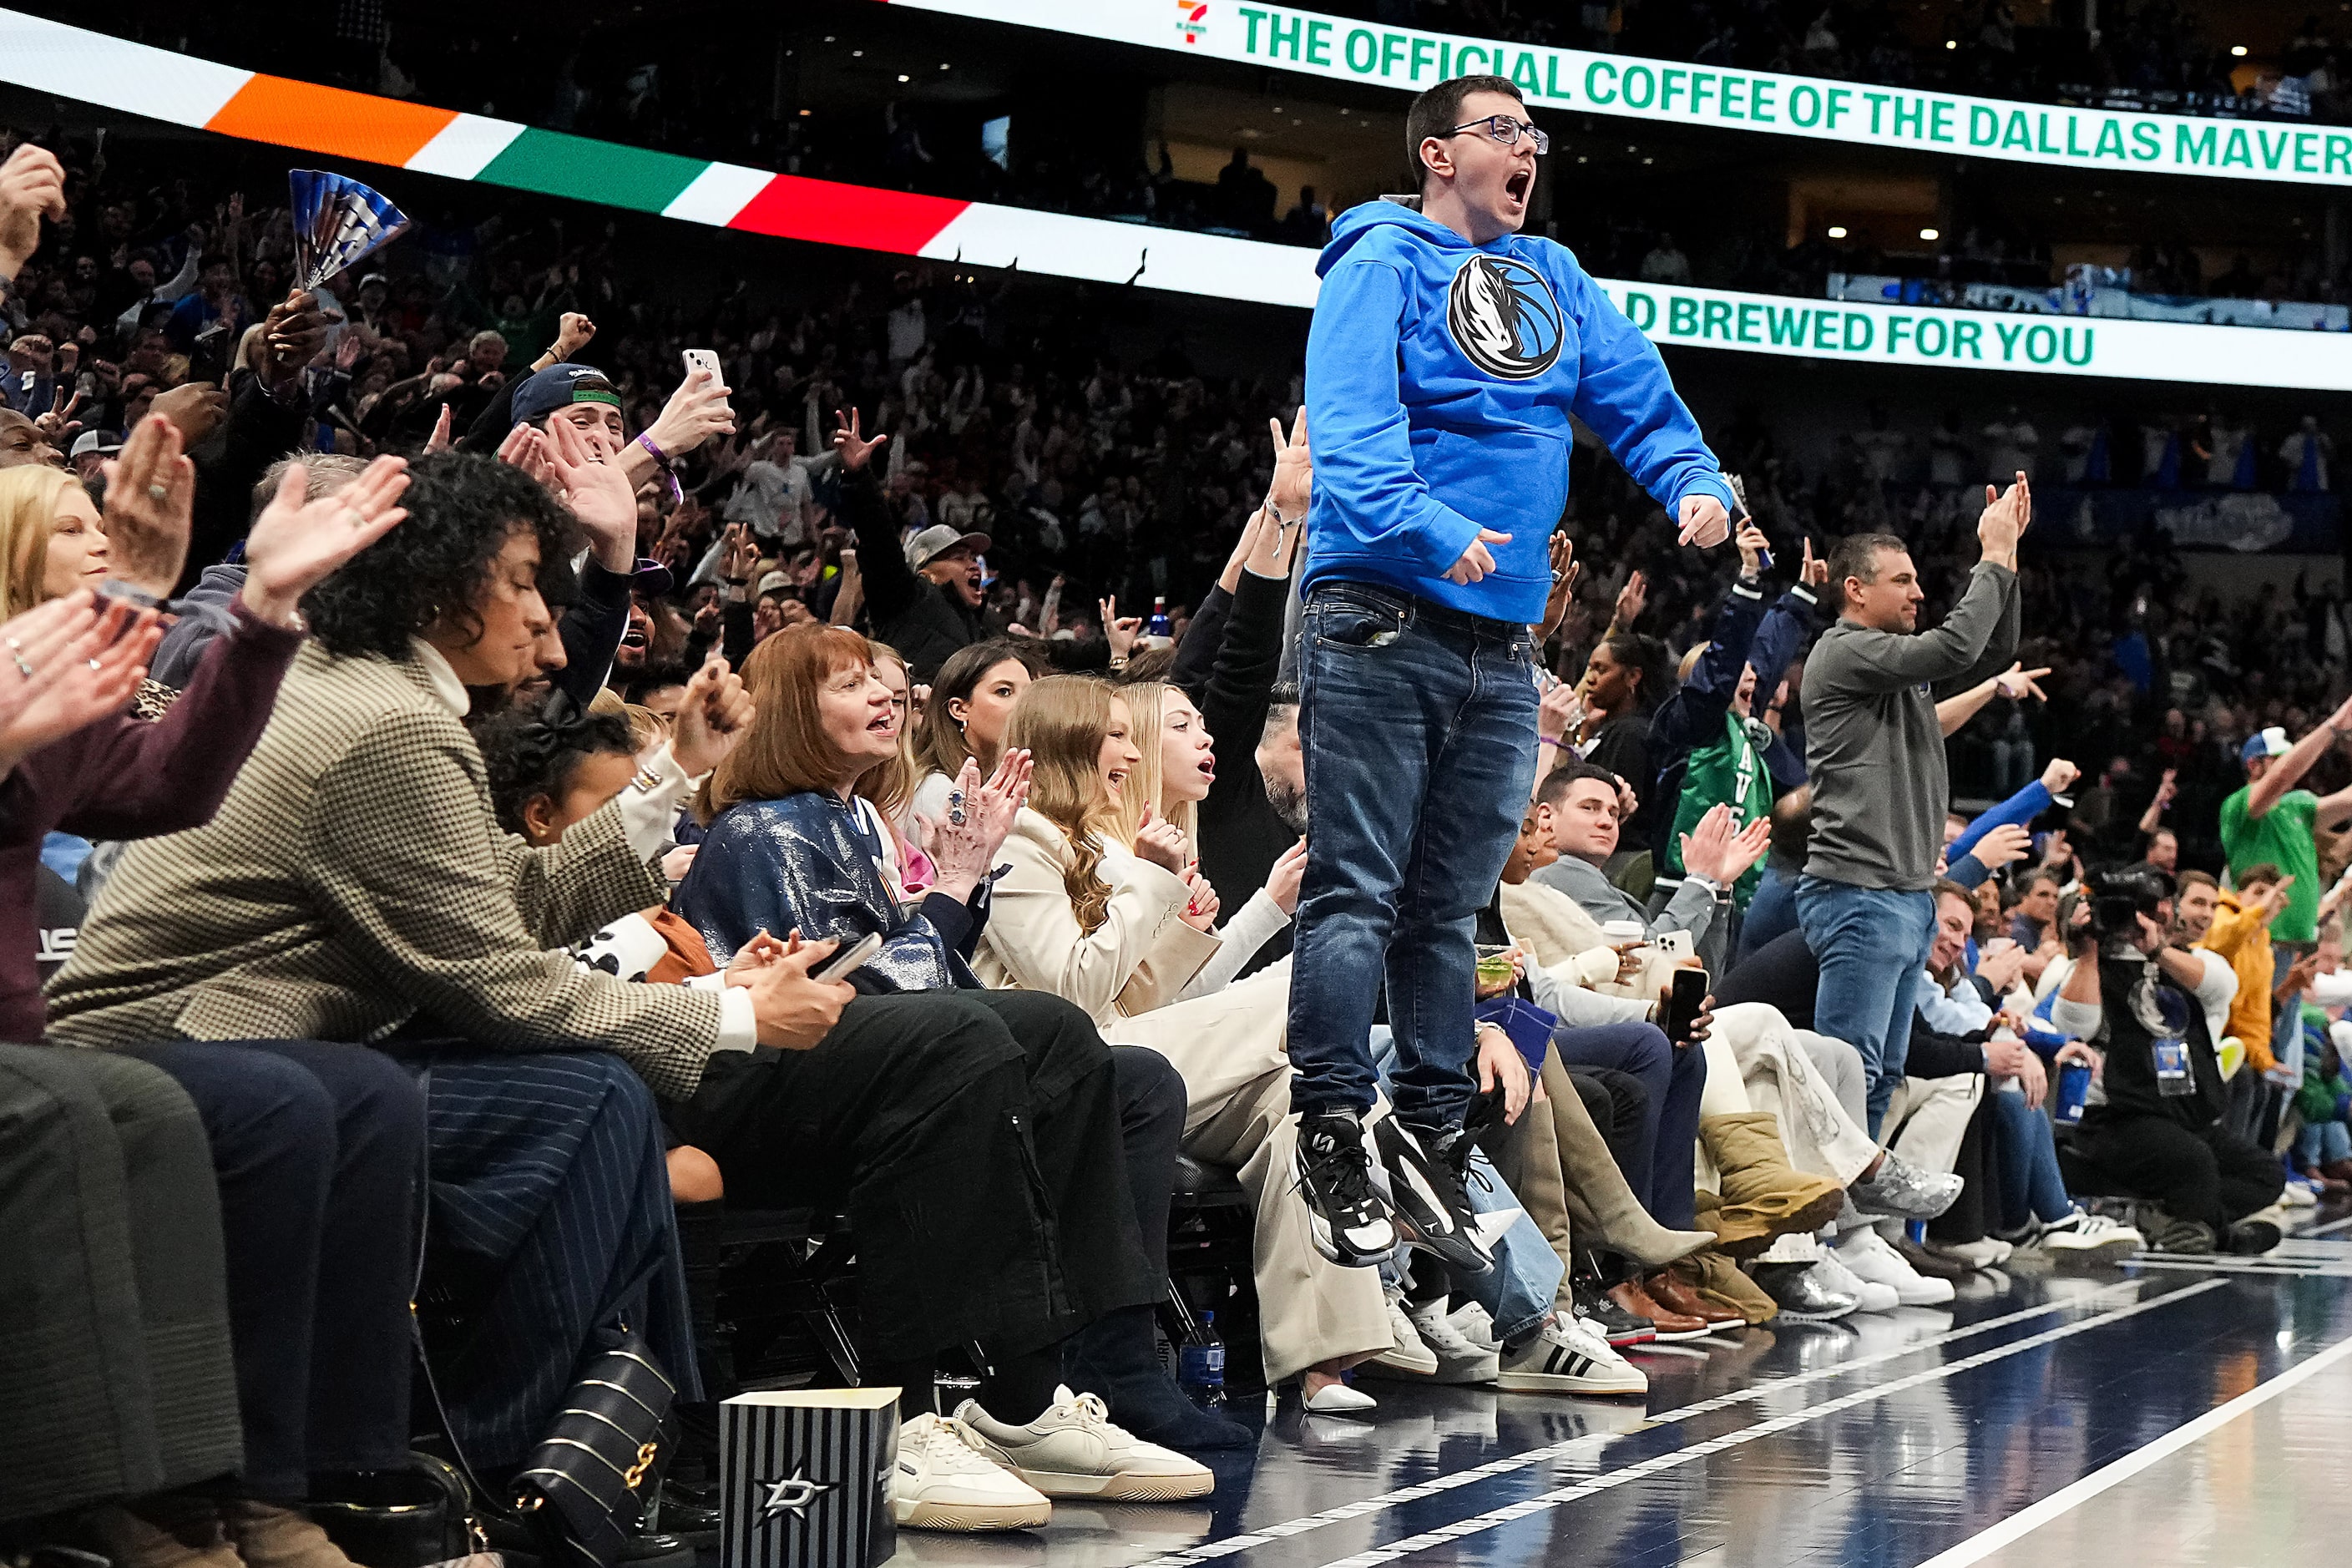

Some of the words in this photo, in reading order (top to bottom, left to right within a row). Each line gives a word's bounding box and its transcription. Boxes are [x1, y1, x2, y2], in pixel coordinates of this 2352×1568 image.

[1238, 7, 1333, 68] THE
[1345, 28, 1571, 100] OFFICIAL
[1584, 60, 1778, 123] COFFEE
[1788, 84, 1853, 129] OF
[1863, 92, 1956, 144] THE
[1969, 104, 2162, 162] DALLAS
[2175, 124, 2352, 176] MAVER
[1626, 291, 1658, 332] D
[1668, 296, 1875, 352] BREWED
[1886, 315, 1984, 360] FOR
[1995, 321, 2095, 367] YOU
[1728, 731, 1753, 837] AVS
